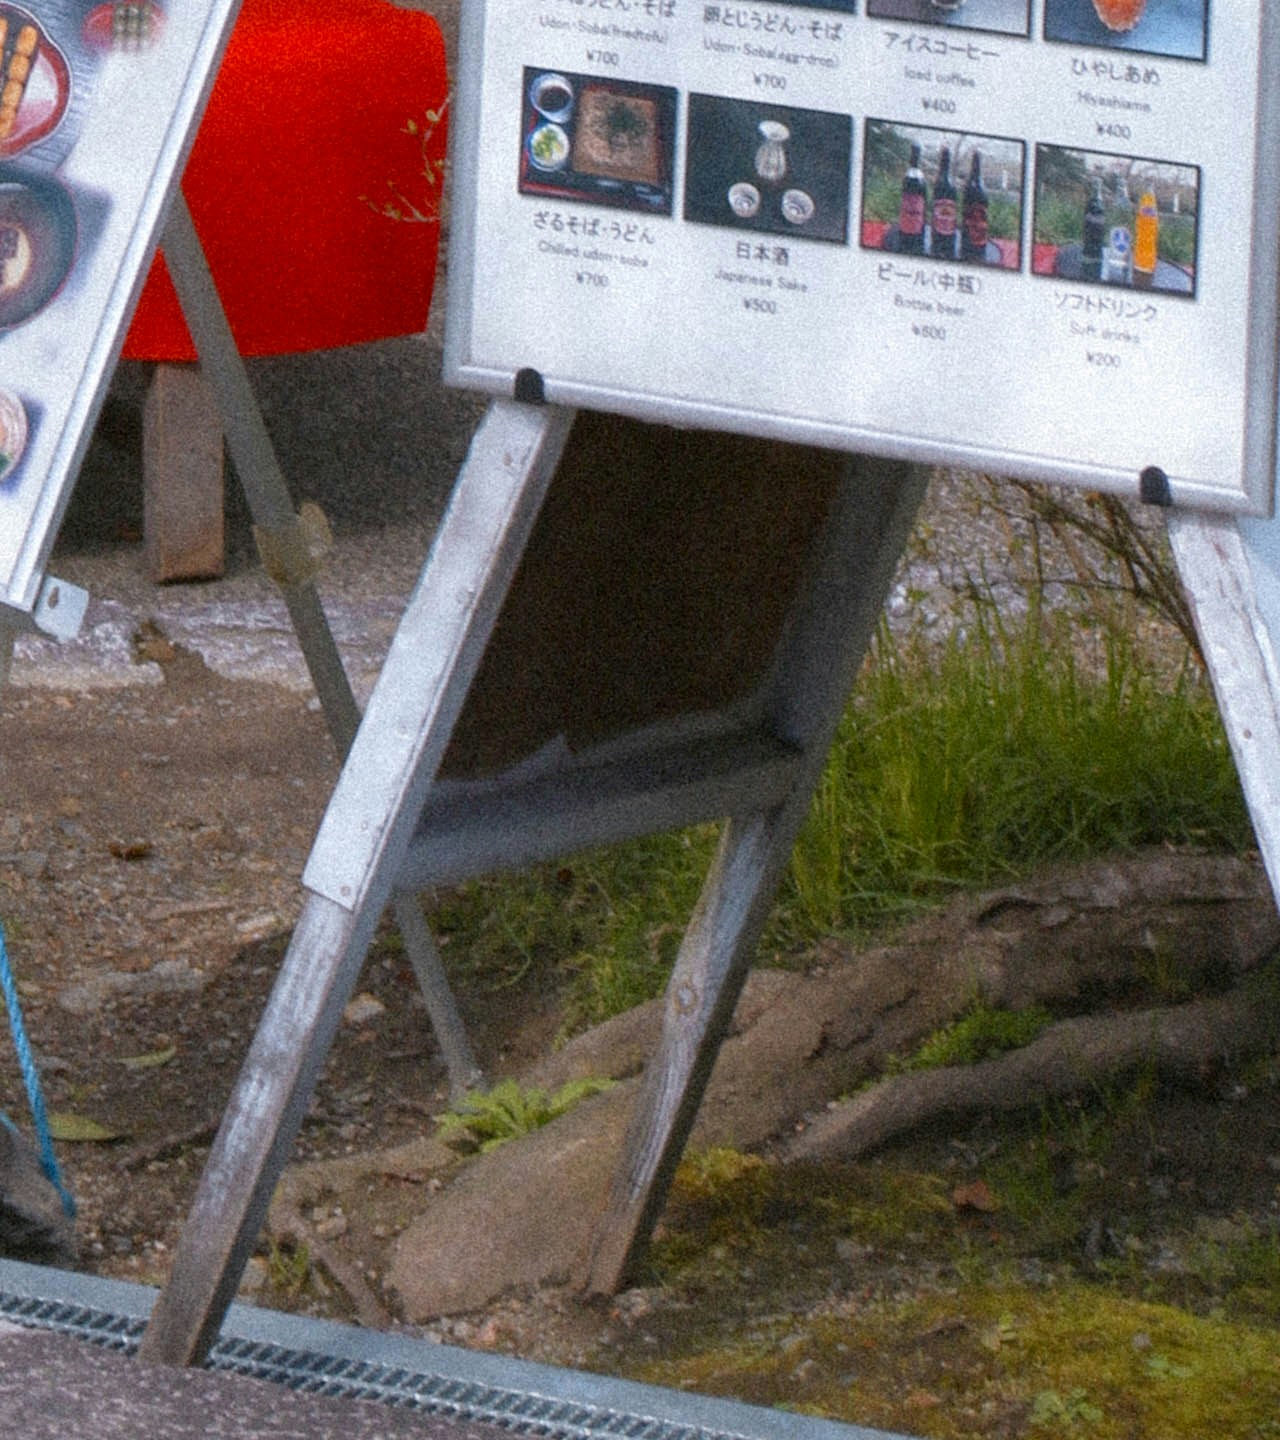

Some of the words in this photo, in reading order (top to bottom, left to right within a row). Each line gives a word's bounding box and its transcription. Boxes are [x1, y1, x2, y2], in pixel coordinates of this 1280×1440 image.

[883, 32, 1000, 62] アイスコーヒー
[586, 48, 620, 67] ¥700
[753, 71, 787, 90] ¥700
[1071, 57, 1161, 87] ひやしあめ
[921, 97, 957, 115] ¥400
[1096, 121, 1132, 140] ¥400
[736, 241, 790, 267] 日本酒
[576, 270, 610, 288] ¥700
[1053, 290, 1159, 322] ソフトドリンク
